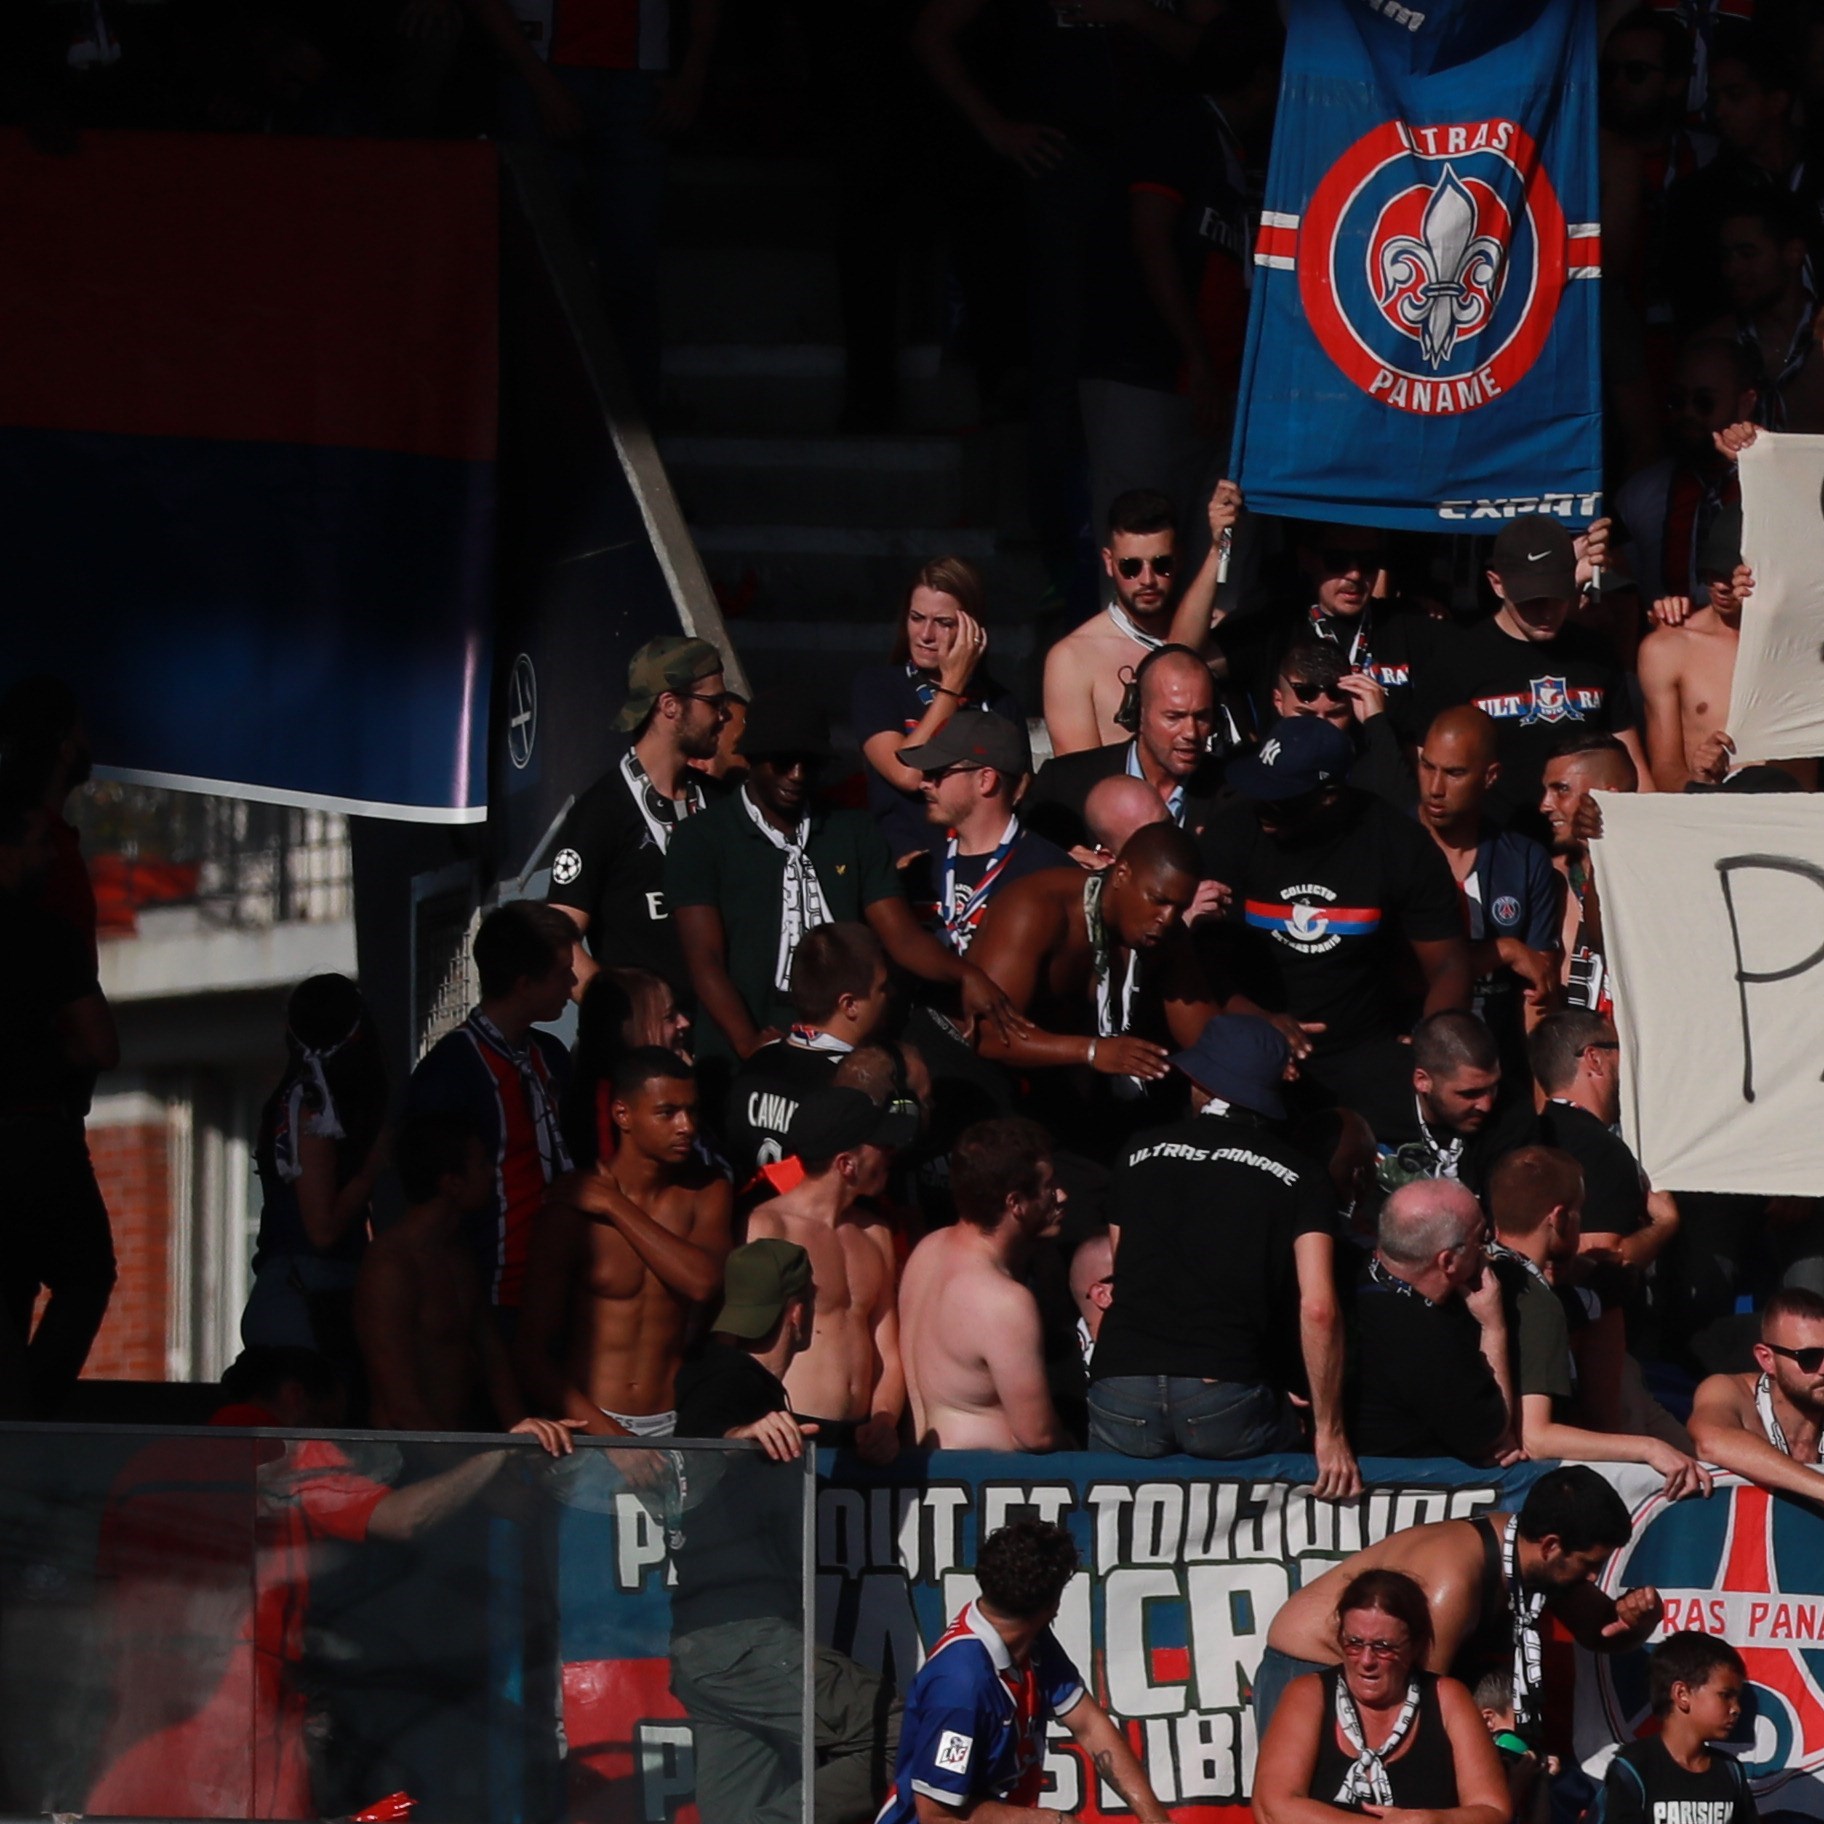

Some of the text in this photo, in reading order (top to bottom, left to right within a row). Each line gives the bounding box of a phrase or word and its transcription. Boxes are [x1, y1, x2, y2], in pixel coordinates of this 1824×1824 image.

[1368, 367, 1502, 413] PANAME
[1437, 492, 1603, 520] EXPAT
[1128, 1142, 1301, 1187] ULTRAS PANAME
